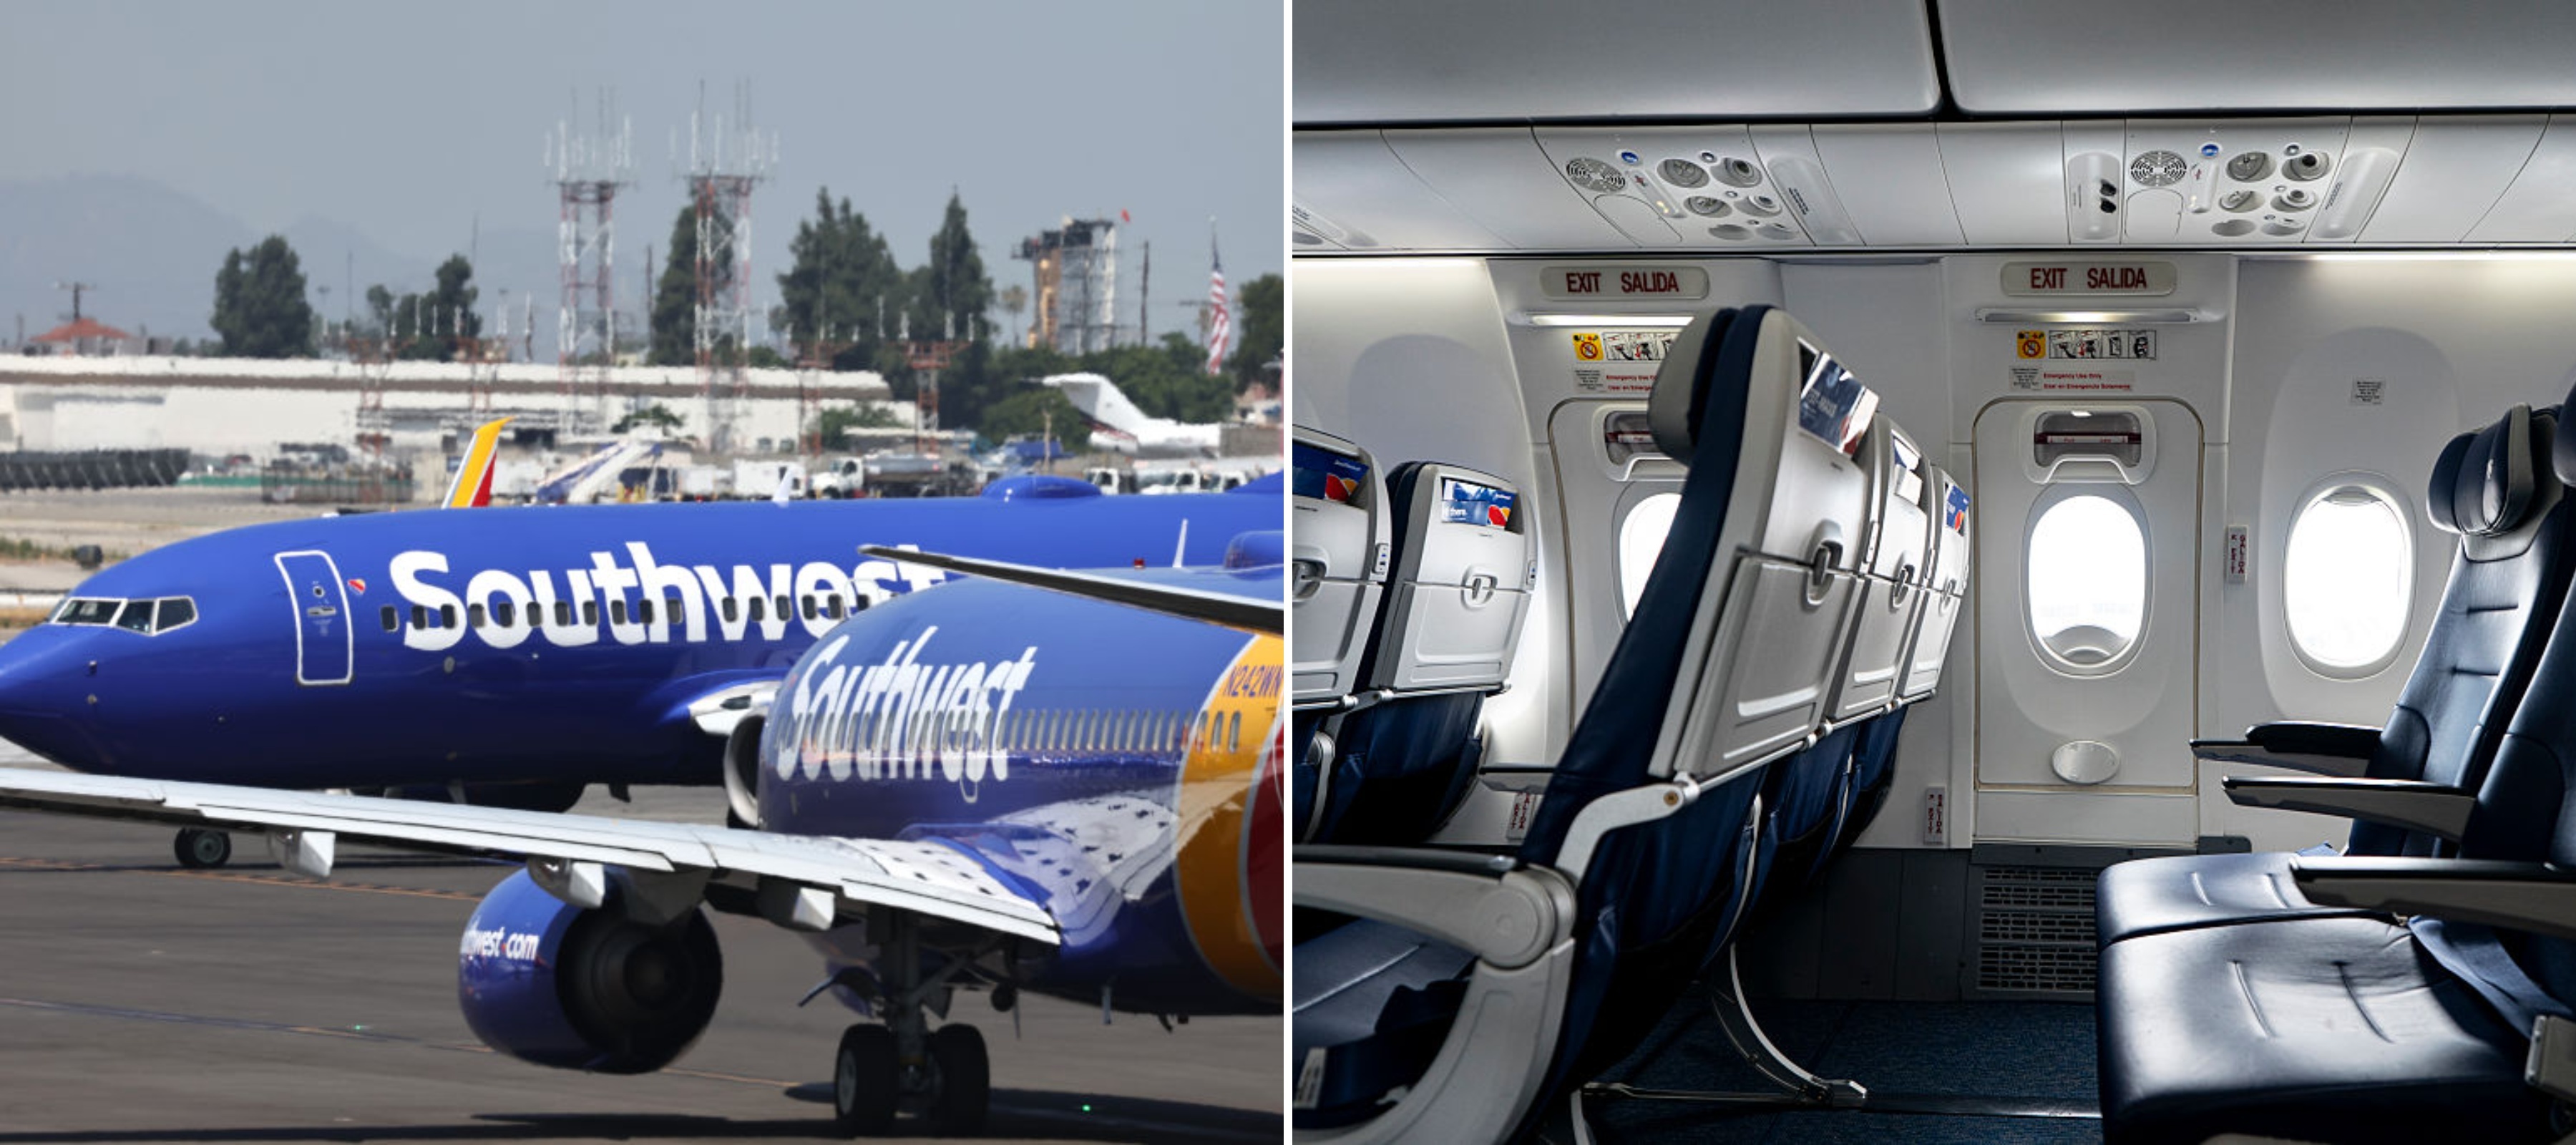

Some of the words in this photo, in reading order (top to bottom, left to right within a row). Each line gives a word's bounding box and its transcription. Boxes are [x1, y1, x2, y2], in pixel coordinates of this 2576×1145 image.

[1565, 272, 1601, 293] EXIT
[1620, 271, 1680, 293] SALIDA
[2030, 267, 2068, 289] EXIT
[2087, 267, 2147, 289] SALIDA
[776, 625, 1038, 782] Southwest
